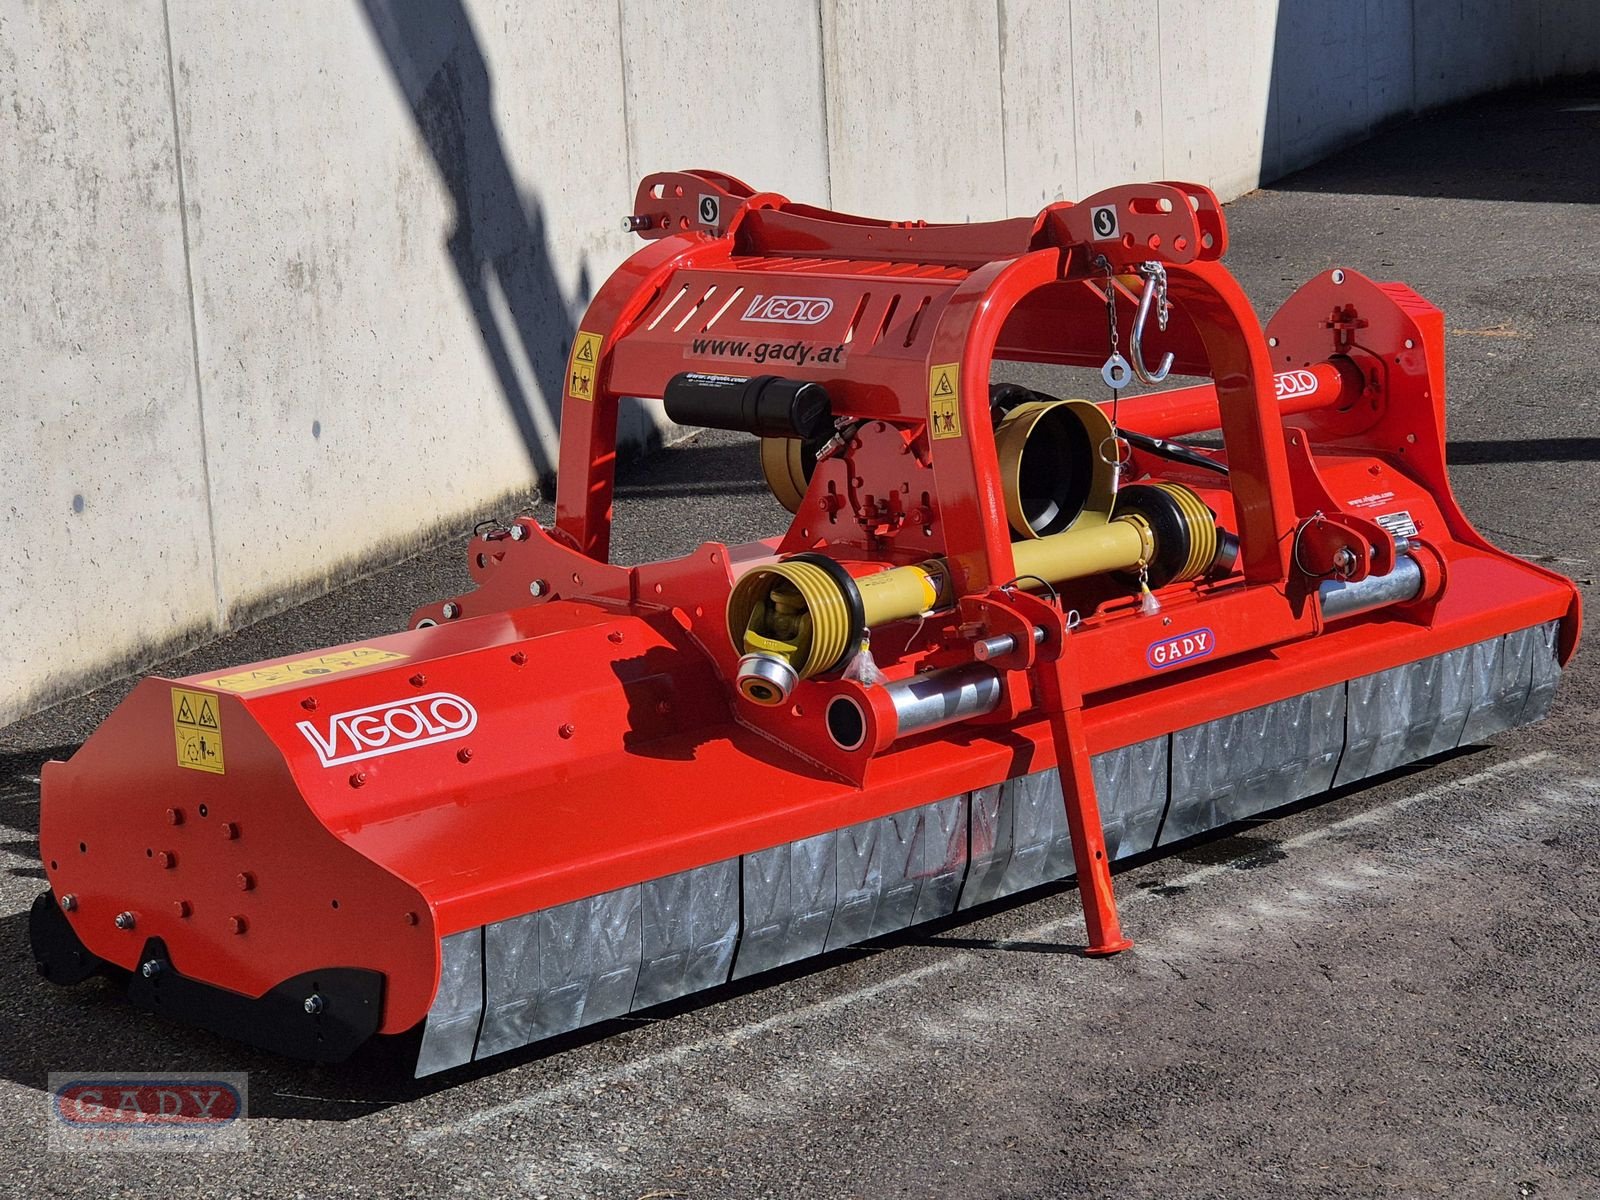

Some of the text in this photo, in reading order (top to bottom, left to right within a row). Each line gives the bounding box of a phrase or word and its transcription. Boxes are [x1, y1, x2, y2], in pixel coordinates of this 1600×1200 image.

[743, 295, 832, 324] VIGOLO
[692, 338, 844, 365] www.gady.at
[1273, 370, 1316, 397] GOLO
[1154, 633, 1207, 663] GADY
[299, 694, 474, 763] VIGOLO
